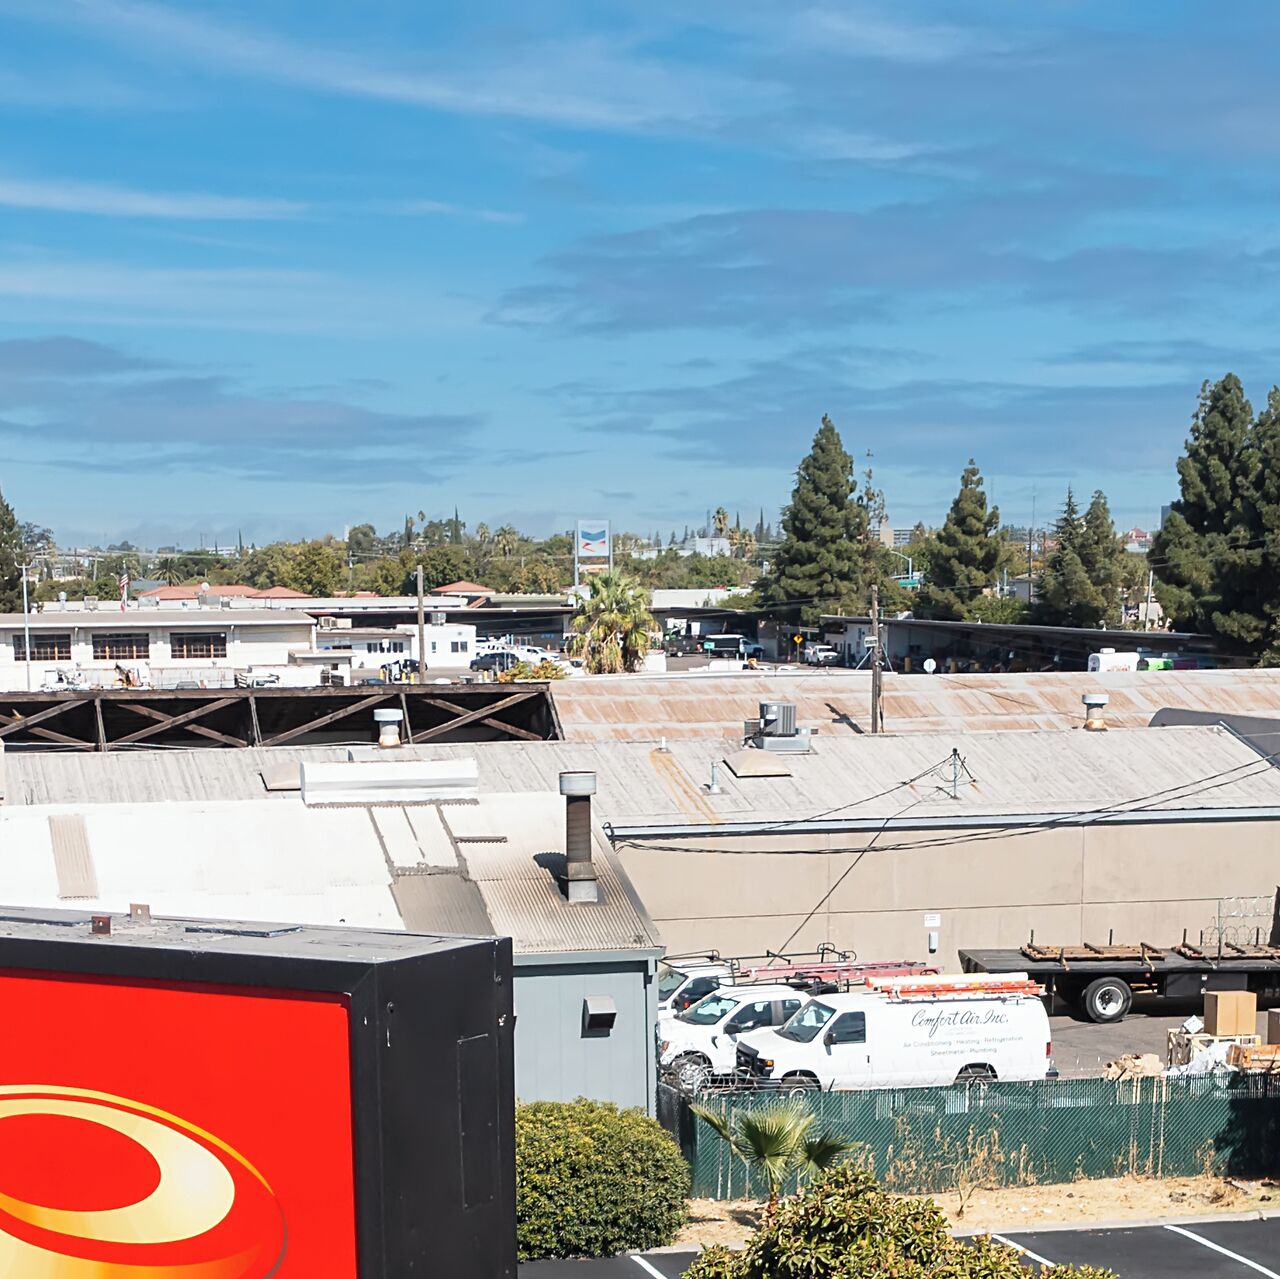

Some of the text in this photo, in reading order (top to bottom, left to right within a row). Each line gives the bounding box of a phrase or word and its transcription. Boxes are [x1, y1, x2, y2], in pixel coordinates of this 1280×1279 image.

[911, 1008, 960, 1038] Comfort
[982, 1008, 1009, 1025] Inc.
[913, 1039, 952, 1048] Conditioning
[956, 1038, 980, 1046] Heating
[984, 1035, 1024, 1044] Refrigeration
